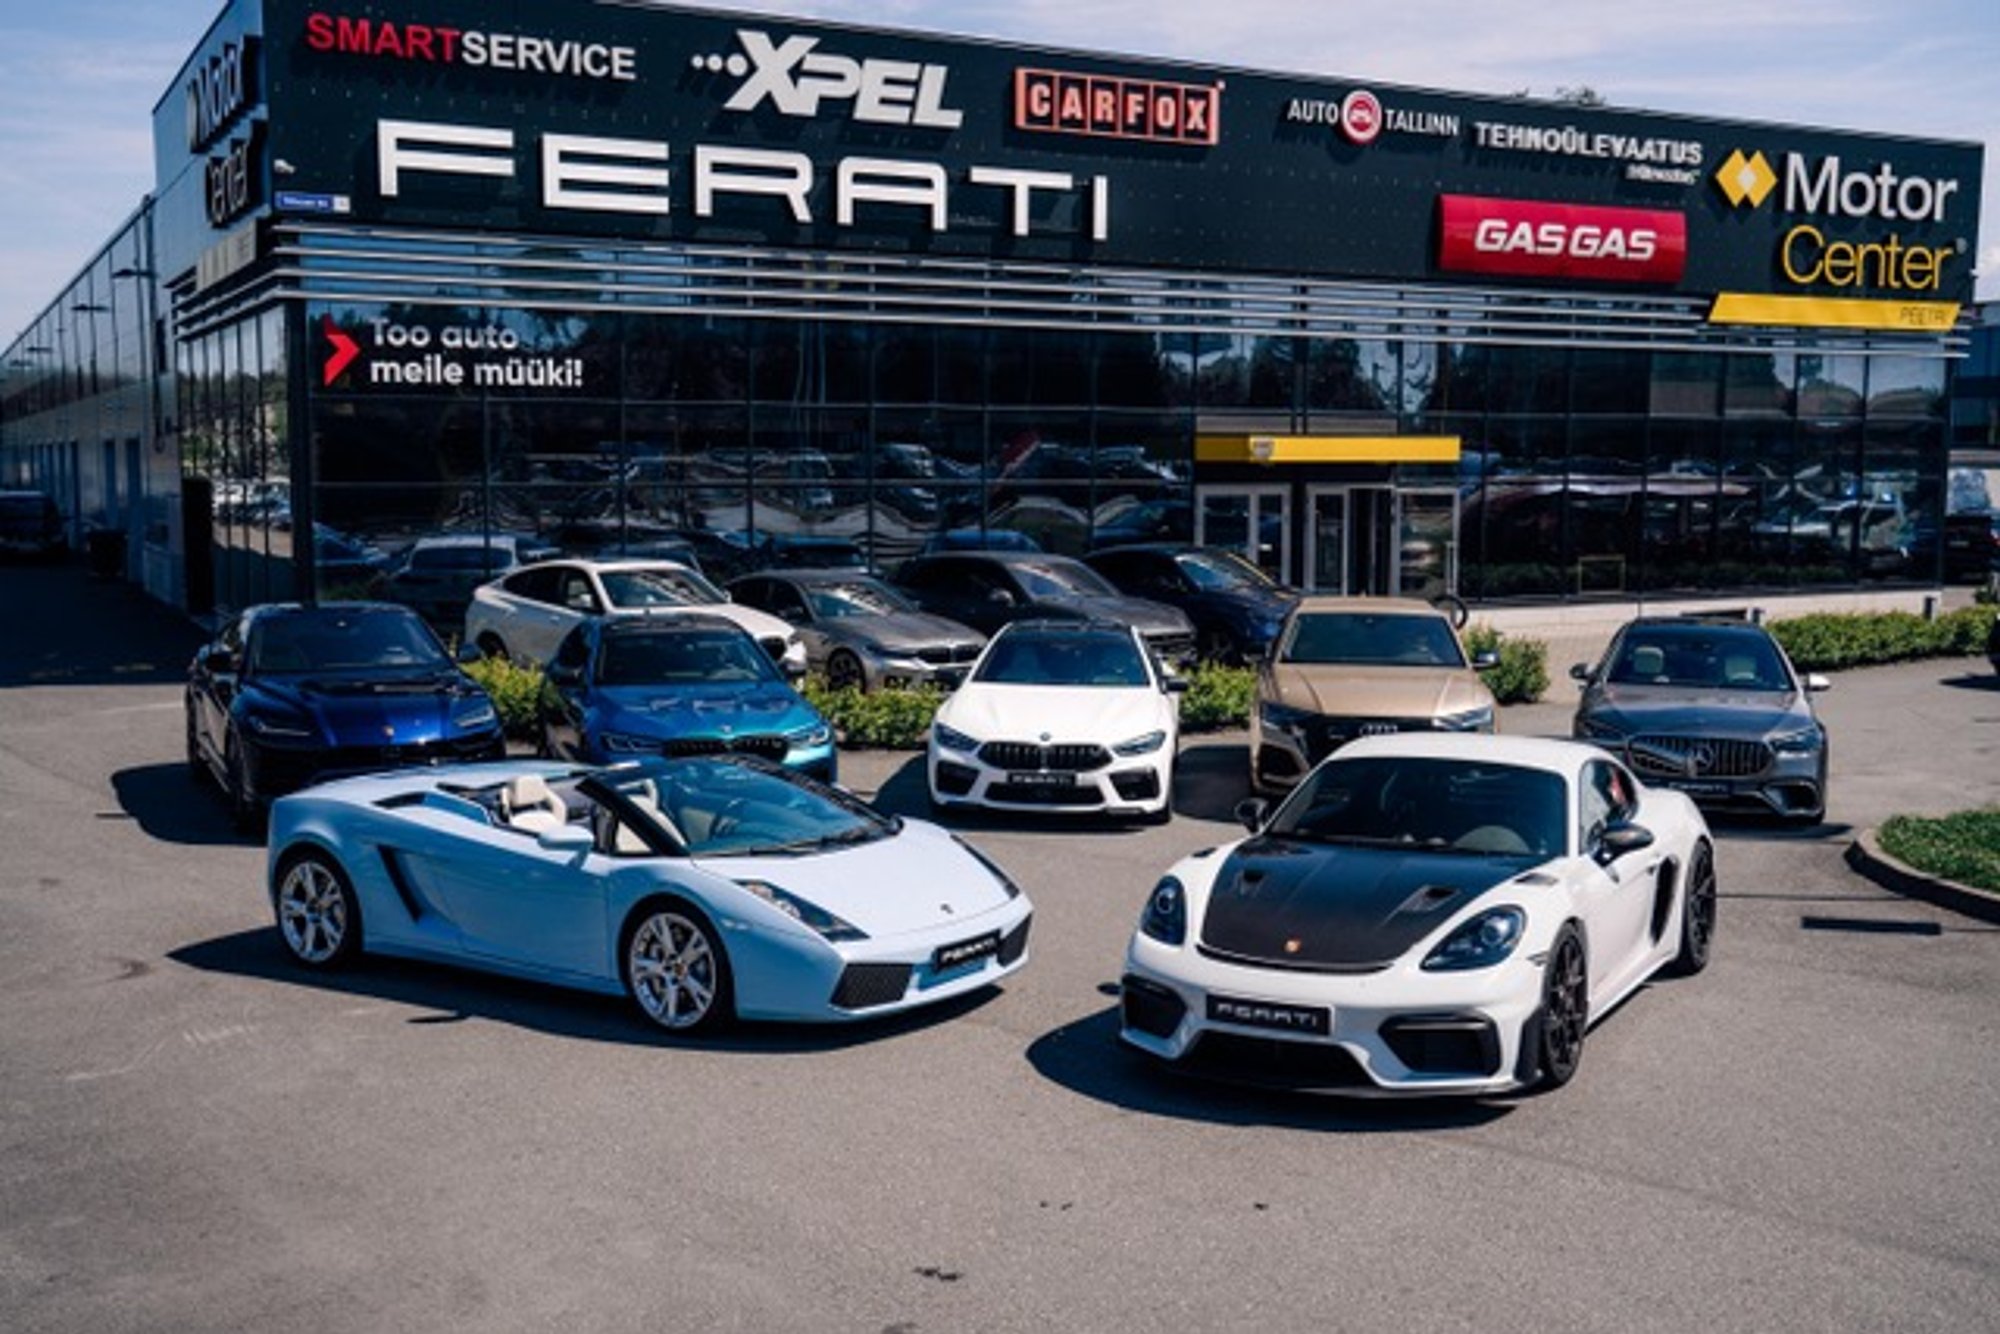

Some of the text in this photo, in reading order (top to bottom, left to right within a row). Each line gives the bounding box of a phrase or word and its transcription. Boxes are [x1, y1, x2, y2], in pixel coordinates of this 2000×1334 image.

[307, 13, 636, 80] SMARTSERVICE
[722, 29, 963, 129] XPEL
[1029, 82, 1207, 131] CARFOX
[1287, 98, 1459, 136] AUTO TALLINN
[1475, 121, 1703, 165] TEHNOÜLEVAATUS
[378, 119, 1107, 241] FERATI
[1784, 153, 1957, 221] Motor
[1782, 224, 1952, 290] Center
[368, 316, 519, 349] Too auto
[370, 354, 583, 387] meile müüki!
